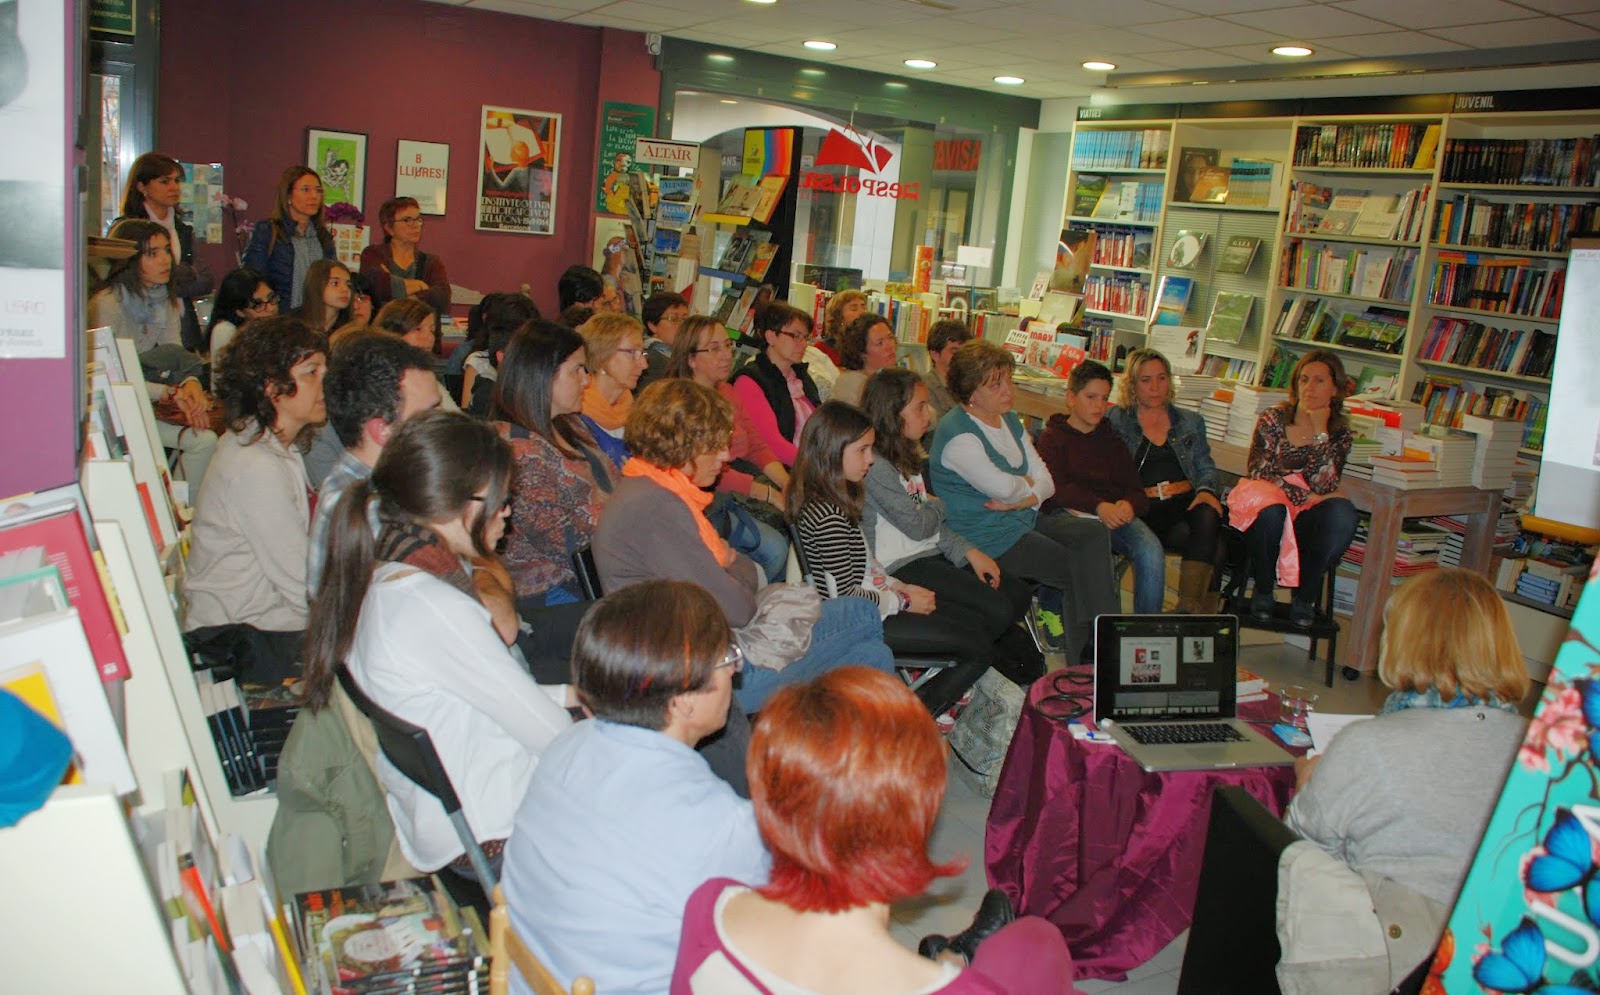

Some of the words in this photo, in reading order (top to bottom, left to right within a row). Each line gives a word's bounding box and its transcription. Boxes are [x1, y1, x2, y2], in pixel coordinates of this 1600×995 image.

[1455, 95, 1494, 108] JUVENIL
[1080, 108, 1102, 119] VIATGES
[642, 145, 692, 161] ALTAÏR
[1030, 330, 1055, 343] MARX
